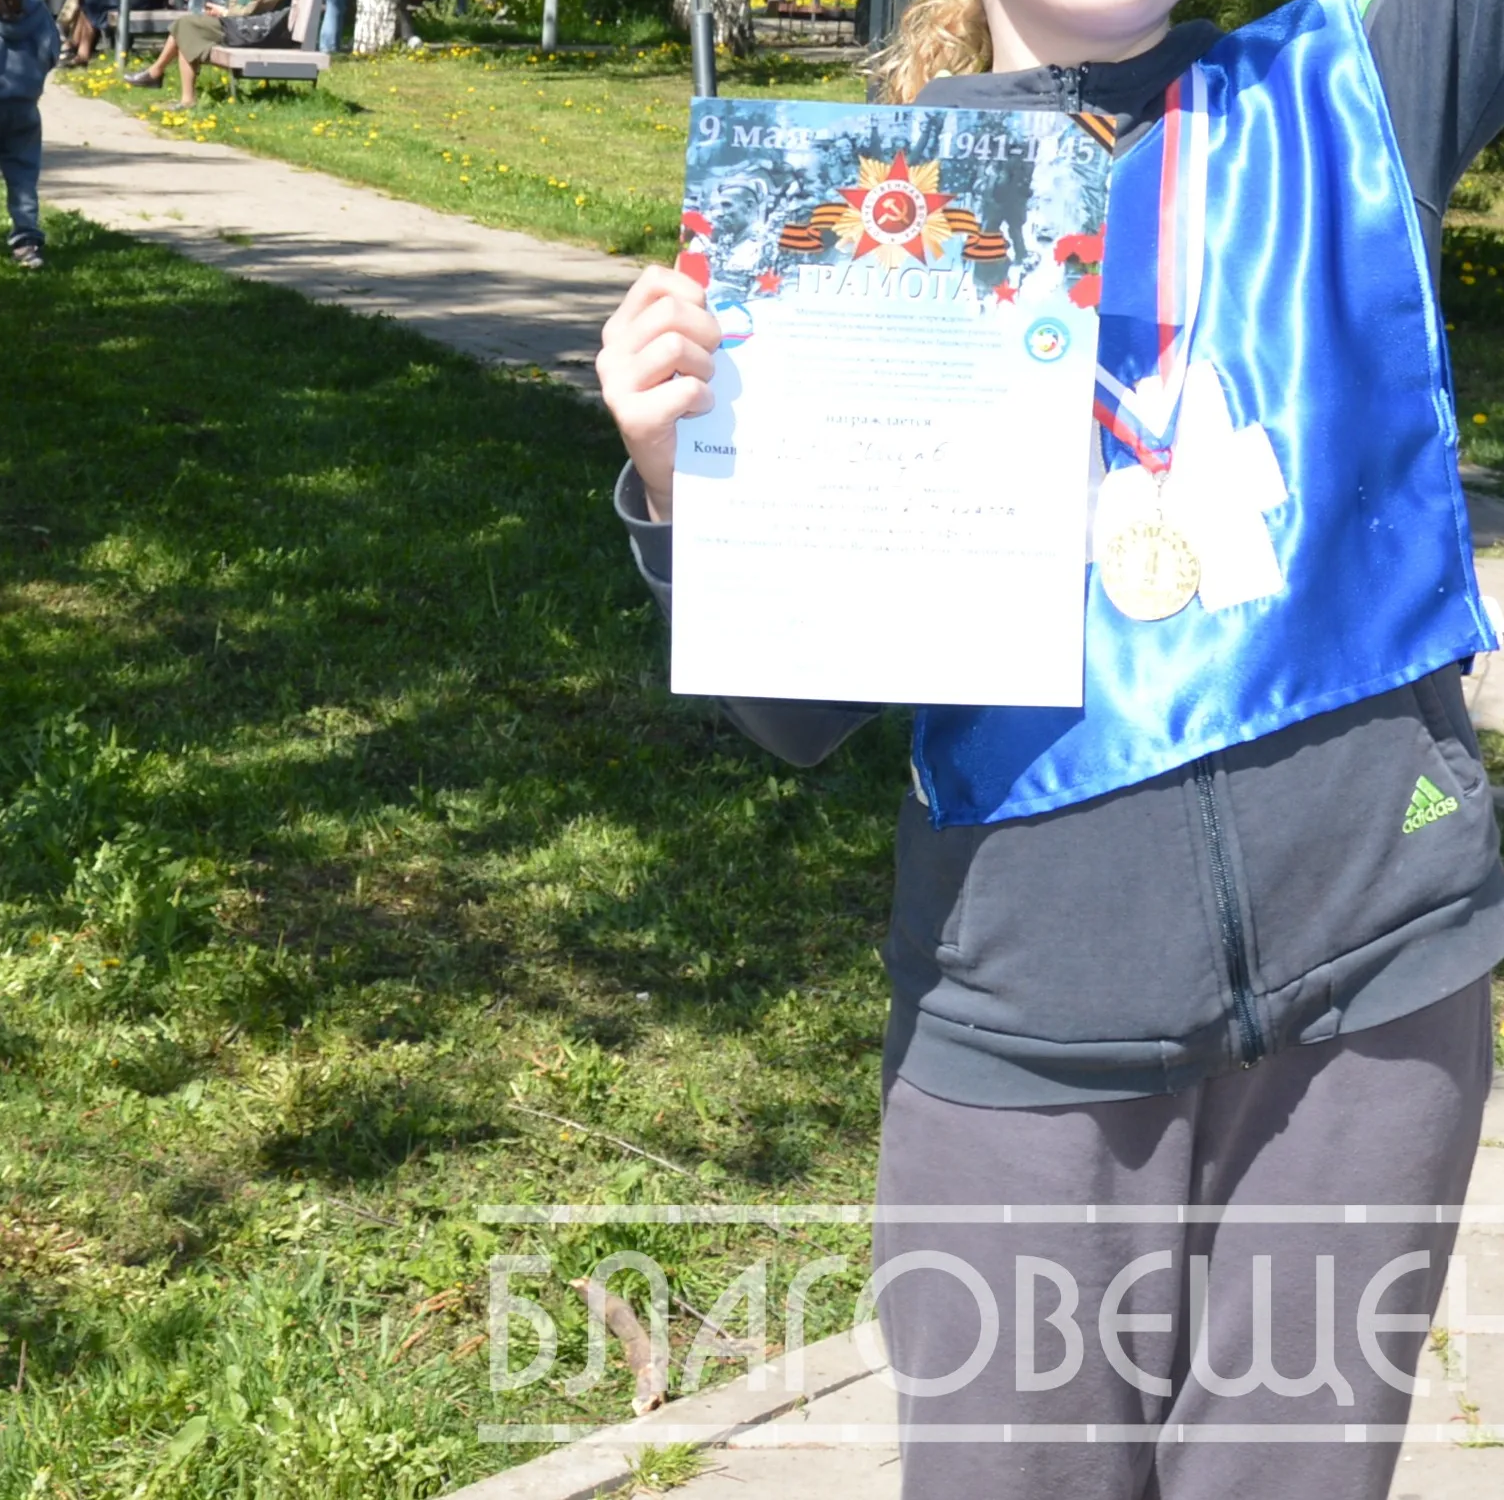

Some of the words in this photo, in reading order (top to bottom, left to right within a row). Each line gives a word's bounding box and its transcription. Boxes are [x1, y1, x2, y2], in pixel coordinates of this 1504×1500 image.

[697, 115, 721, 147] 9
[730, 124, 815, 149] мая
[938, 132, 1096, 164] 1941-145
[796, 263, 980, 303] ГРАМОТА
[1402, 796, 1458, 834] adidas
